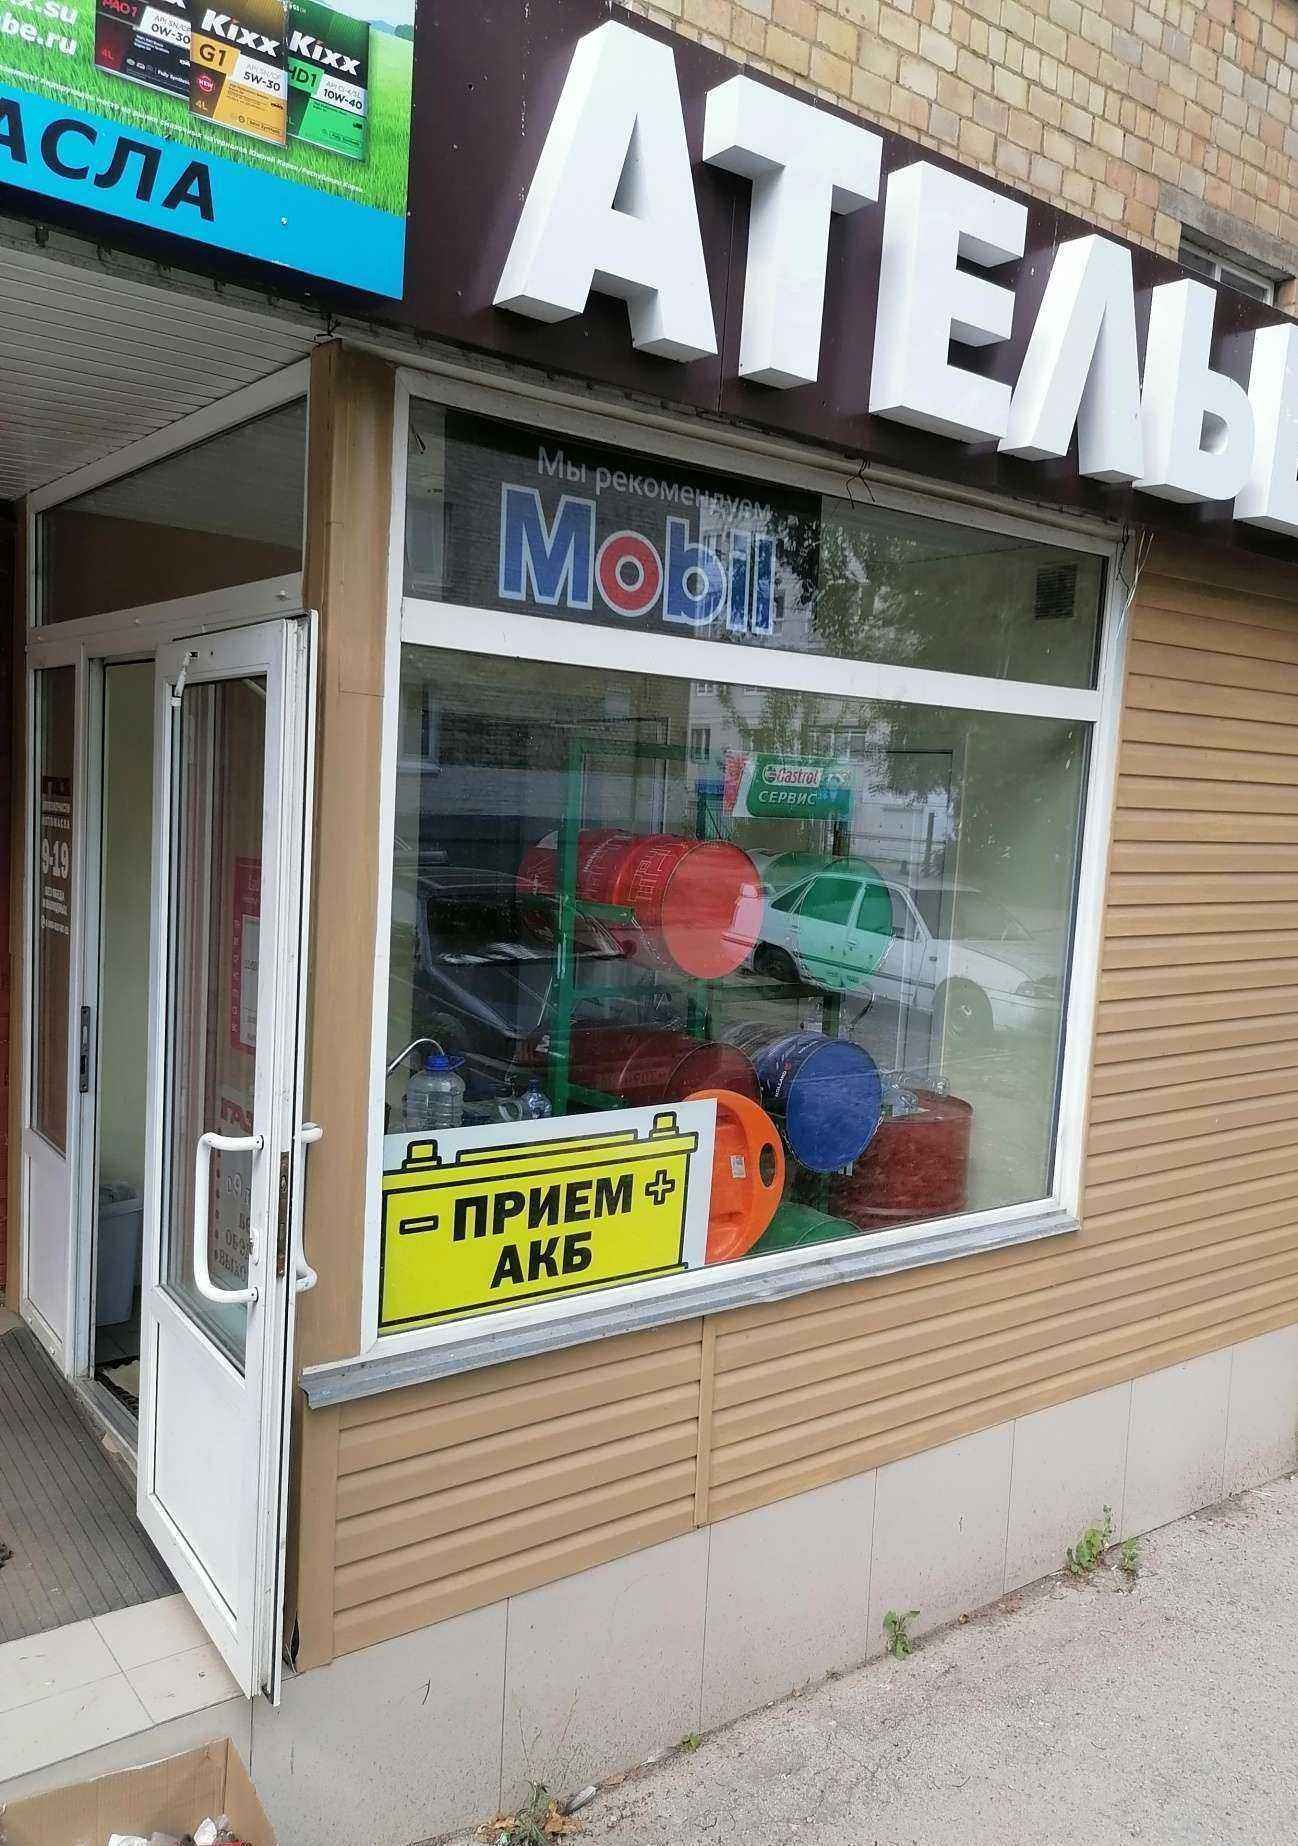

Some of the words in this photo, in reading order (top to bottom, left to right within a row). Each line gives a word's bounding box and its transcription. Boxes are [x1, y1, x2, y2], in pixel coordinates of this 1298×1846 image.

[151, 24, 190, 44] 0W-30
[201, 8, 280, 58] Kixx
[200, 43, 227, 67] G1
[289, 30, 361, 75] Kixx
[243, 71, 281, 92] 5W-30
[324, 88, 362, 110] 10W-40
[537, 446, 587, 483] Мы
[595, 466, 773, 520] рекомендуем
[499, 481, 776, 635] Mobil
[775, 767, 819, 785] Castrol
[758, 790, 818, 806] СЕРВИС
[452, 1173, 633, 1242] ПРИЕМ
[490, 1231, 593, 1290] АКБ
